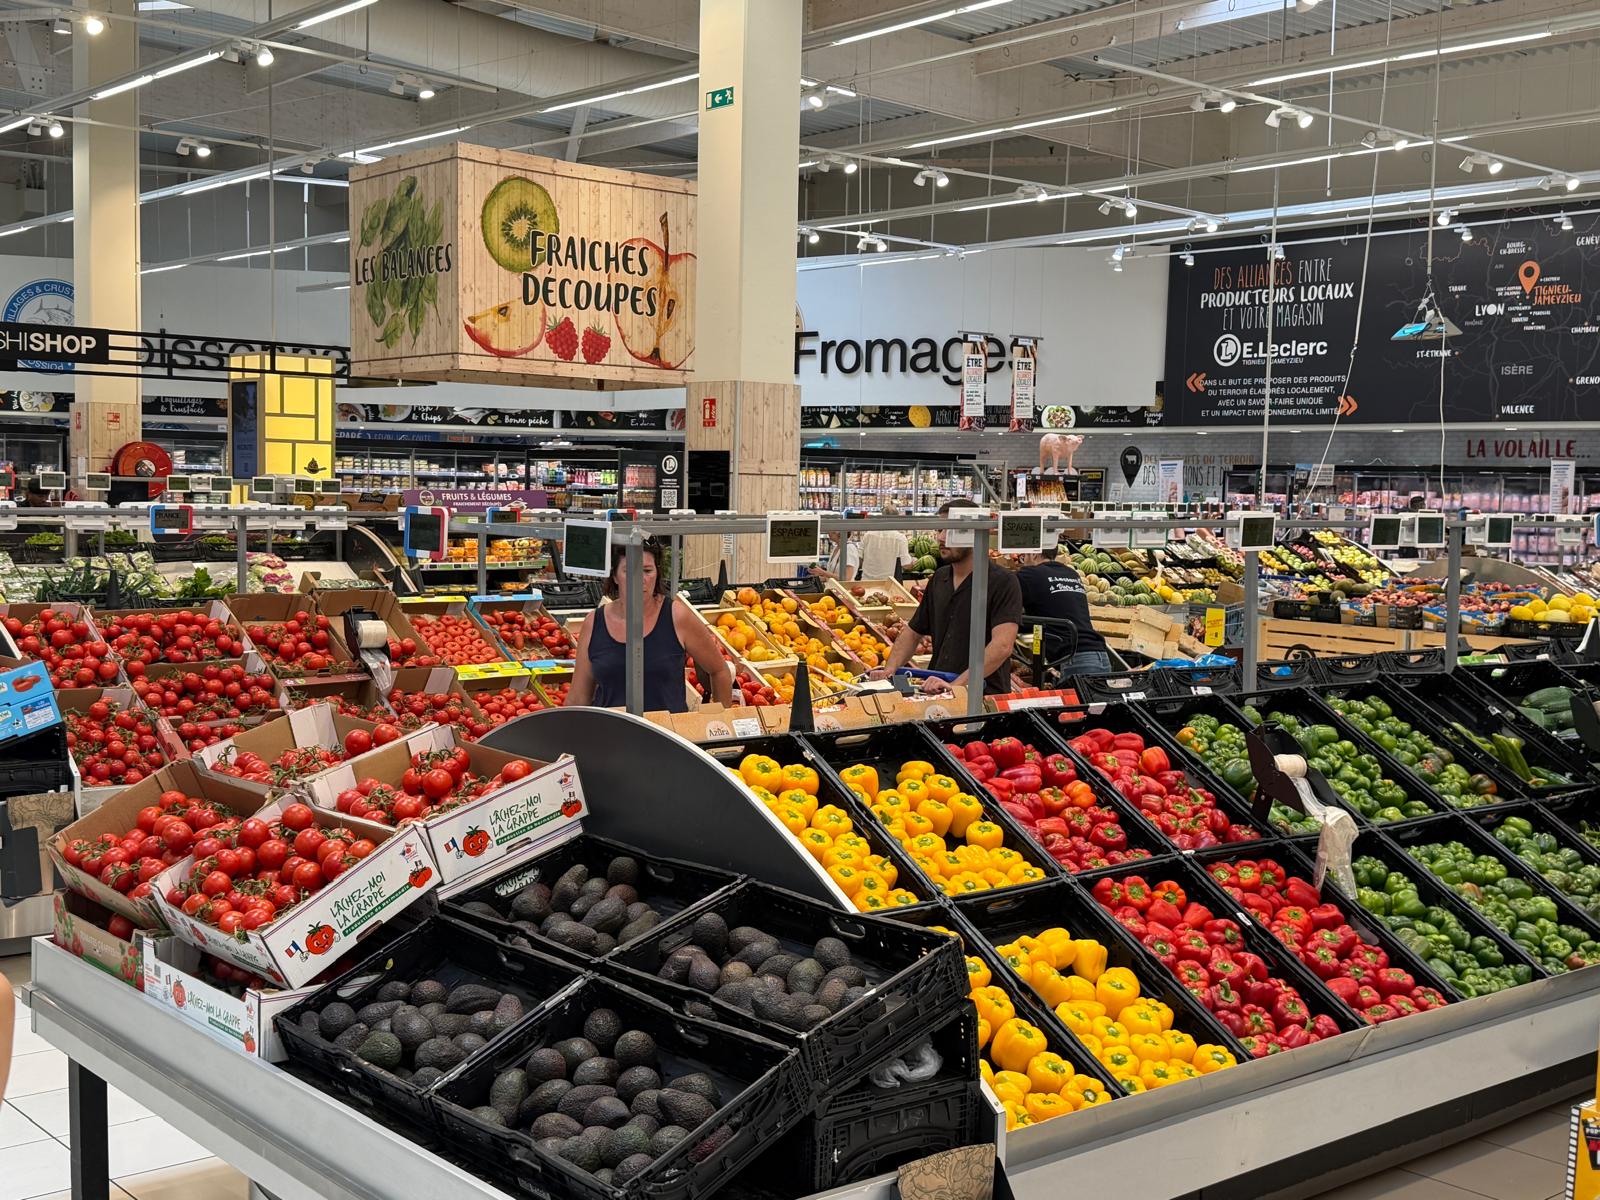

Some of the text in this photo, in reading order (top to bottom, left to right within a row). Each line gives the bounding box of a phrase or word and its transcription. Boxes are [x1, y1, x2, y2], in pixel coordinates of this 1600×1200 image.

[530, 229, 650, 278] FRAICHES
[355, 242, 453, 286] LES BALANCES
[1214, 267, 1232, 290] DES
[1299, 257, 1333, 284] ENTRE
[522, 267, 658, 317] DÉCOUPES
[1200, 282, 1354, 309] PRODUCTEURS LOCAUX
[1534, 284, 1573, 296] TIGNIEU-
[7, 288, 34, 322] ILLAGES
[1532, 293, 1582, 306] JAMEYZIEU
[1222, 303, 1324, 331] ET VOTRE MAGASIN
[1242, 340, 1328, 358] E.Leclerc
[1501, 365, 1534, 375] ISÈRE
[1218, 378, 1227, 386] LE
[1228, 378, 1242, 386] BUT
[1243, 377, 1252, 385] DE
[1254, 377, 1292, 385] PROPOSER
[1293, 376, 1308, 384] DES
[1309, 375, 1346, 383] PRODUITS
[1219, 388, 1248, 396] TERROIR
[1287, 386, 1335, 394] LOCALEMENT,
[1218, 399, 1235, 407] AVEC
[1296, 397, 1323, 405] UNIQUE
[1501, 404, 1535, 414] VALENCE
[421, 413, 443, 423] Chips
[504, 415, 526, 424] Bonne
[1211, 409, 1220, 417] UN
[1247, 408, 1314, 416] ENVIRONNEMENTAL
[1467, 439, 1486, 458] LA
[1143, 465, 1156, 486] DES
[1206, 465, 1216, 486] ET
[442, 493, 468, 501] FRUITS
[477, 491, 512, 501] LÉGUMES
[155, 511, 181, 519] FRANCE
[772, 527, 812, 537] ESPAGNE
[1003, 522, 1035, 531] ESPAGNE
[489, 793, 542, 825] LÂCHEZ-MOI
[493, 808, 540, 838] LA GRAPPE
[329, 871, 386, 918] LÂCHEZ-MOI
[337, 886, 386, 930] LA GRAPPE
